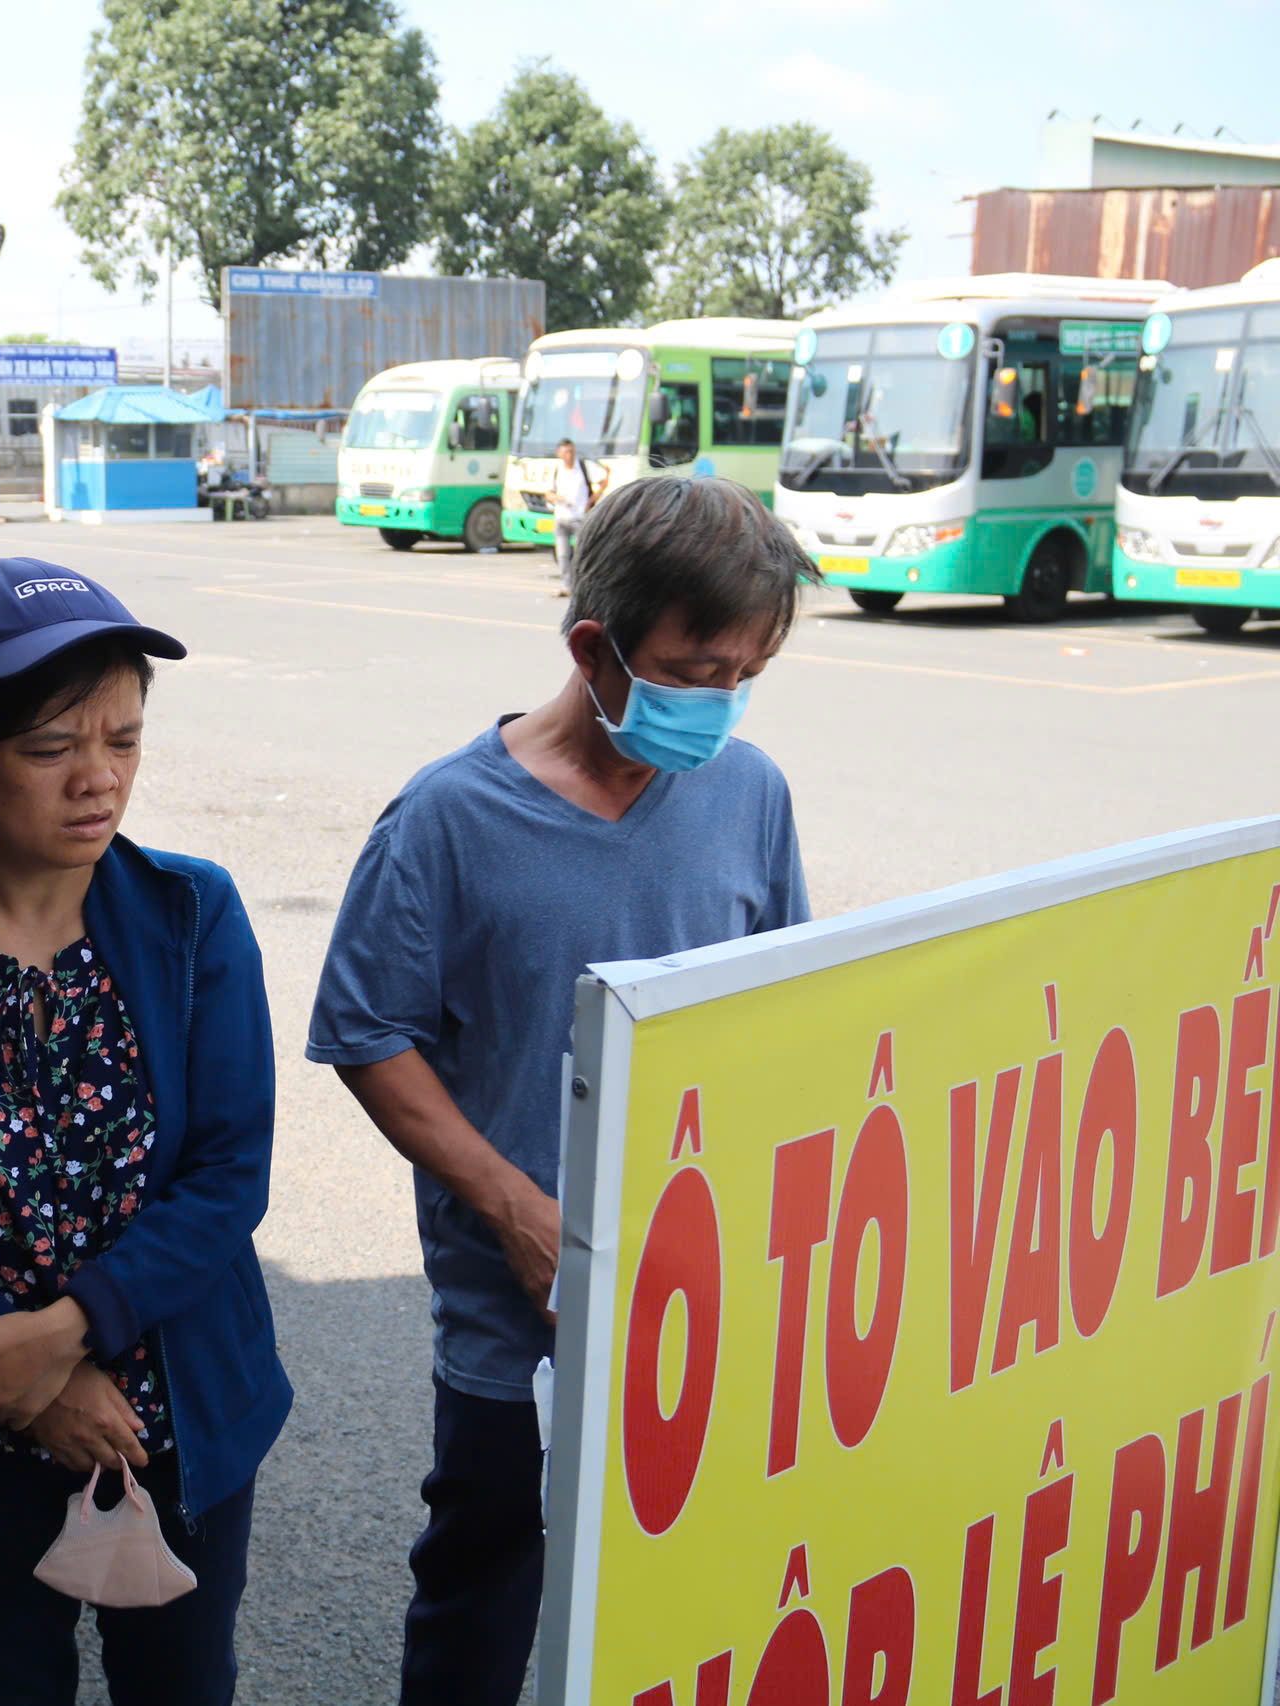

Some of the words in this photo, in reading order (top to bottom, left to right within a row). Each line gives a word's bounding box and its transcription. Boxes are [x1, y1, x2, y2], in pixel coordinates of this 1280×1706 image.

[951, 326, 963, 354] 1
[16, 579, 89, 599] SPACE
[623, 1087, 722, 1536] Ô
[766, 1030, 910, 1479] TÔ
[950, 983, 1138, 1395] VÀO
[1091, 1309, 1276, 1706] PHÍ
